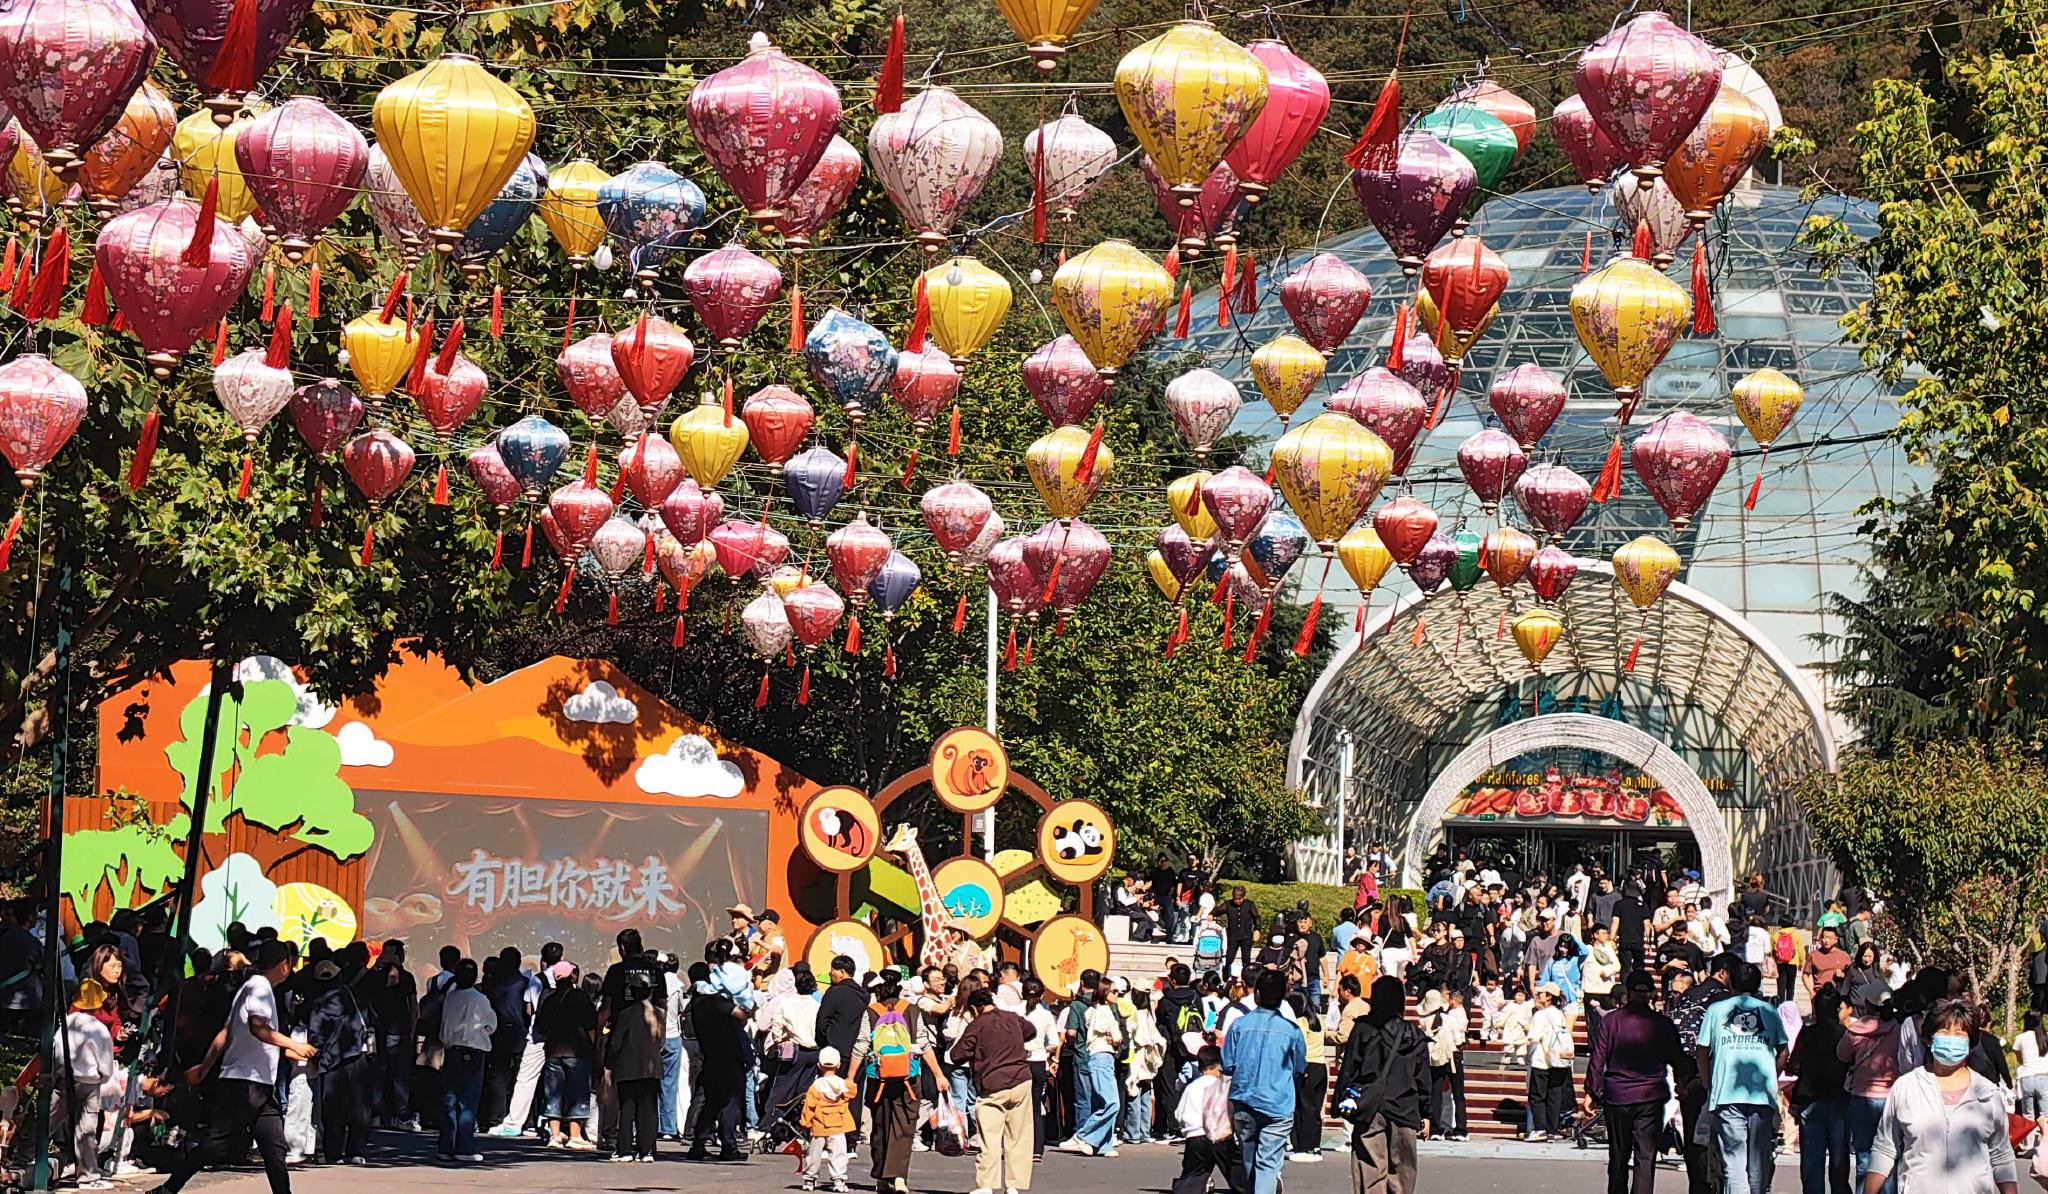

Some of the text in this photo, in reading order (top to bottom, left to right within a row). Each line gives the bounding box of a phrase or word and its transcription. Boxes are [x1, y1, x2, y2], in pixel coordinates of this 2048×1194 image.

[447, 849, 687, 921] 有胆你就来
[1721, 1034, 1770, 1046] DAYDREAM
